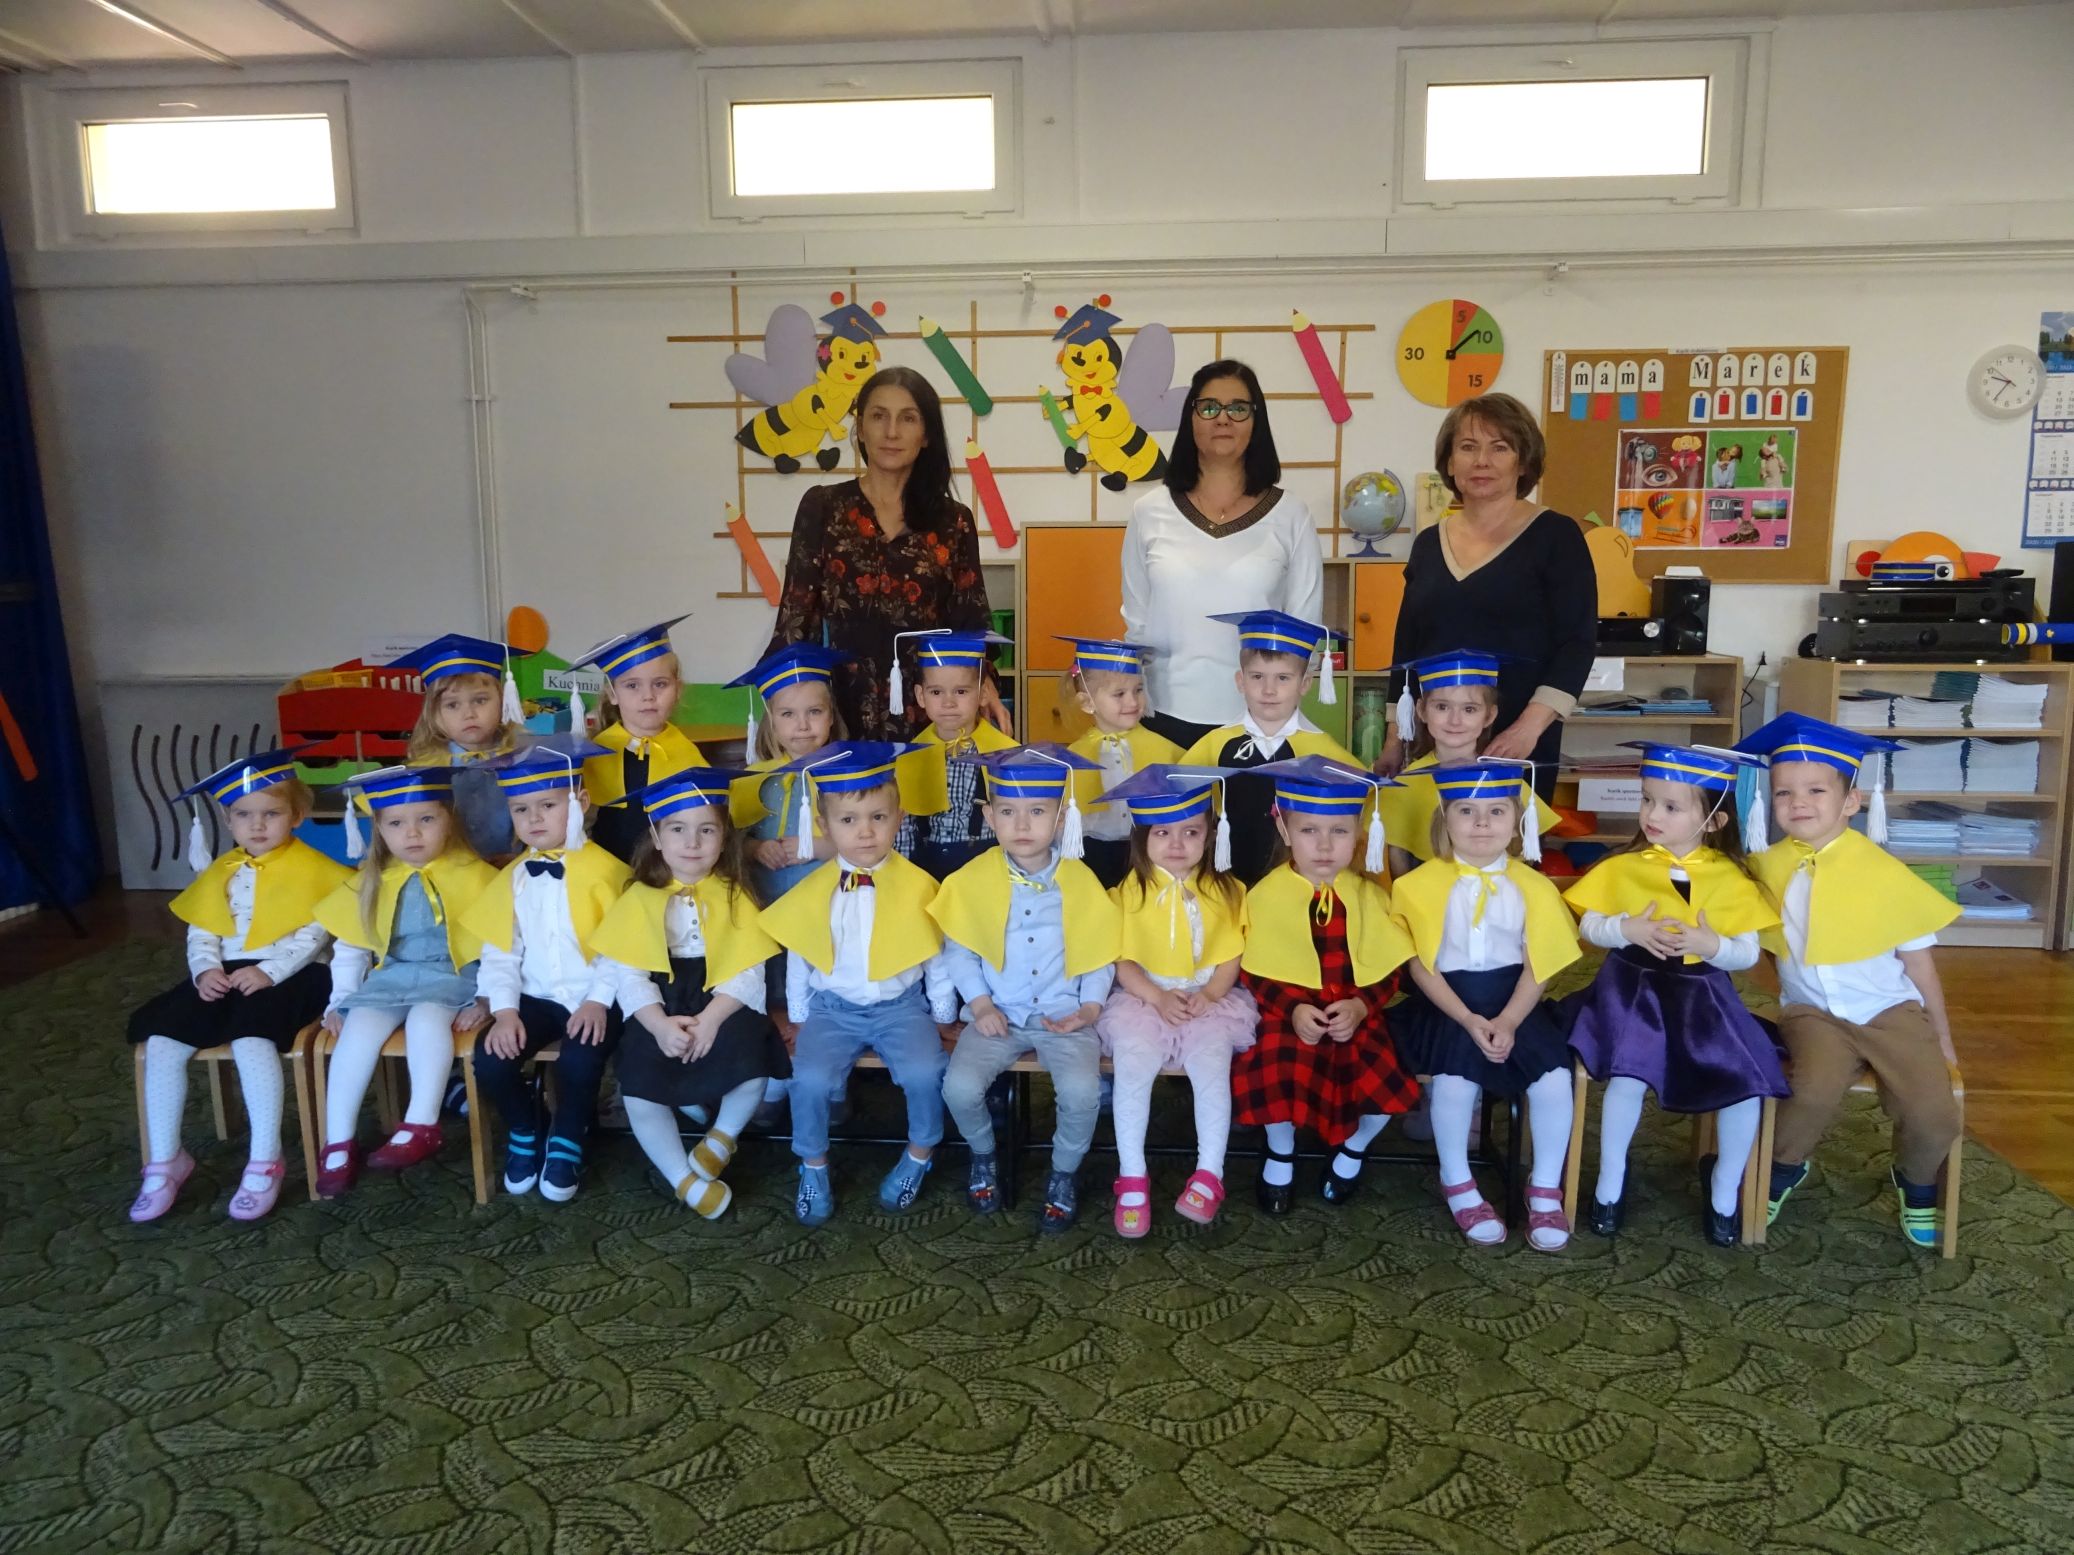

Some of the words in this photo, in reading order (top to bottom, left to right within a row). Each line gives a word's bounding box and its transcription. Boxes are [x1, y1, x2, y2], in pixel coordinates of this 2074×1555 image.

[1457, 310, 1467, 323] 5
[1476, 330, 1493, 344] 10
[1405, 347, 1424, 360] 30
[1468, 374, 1483, 387] 15
